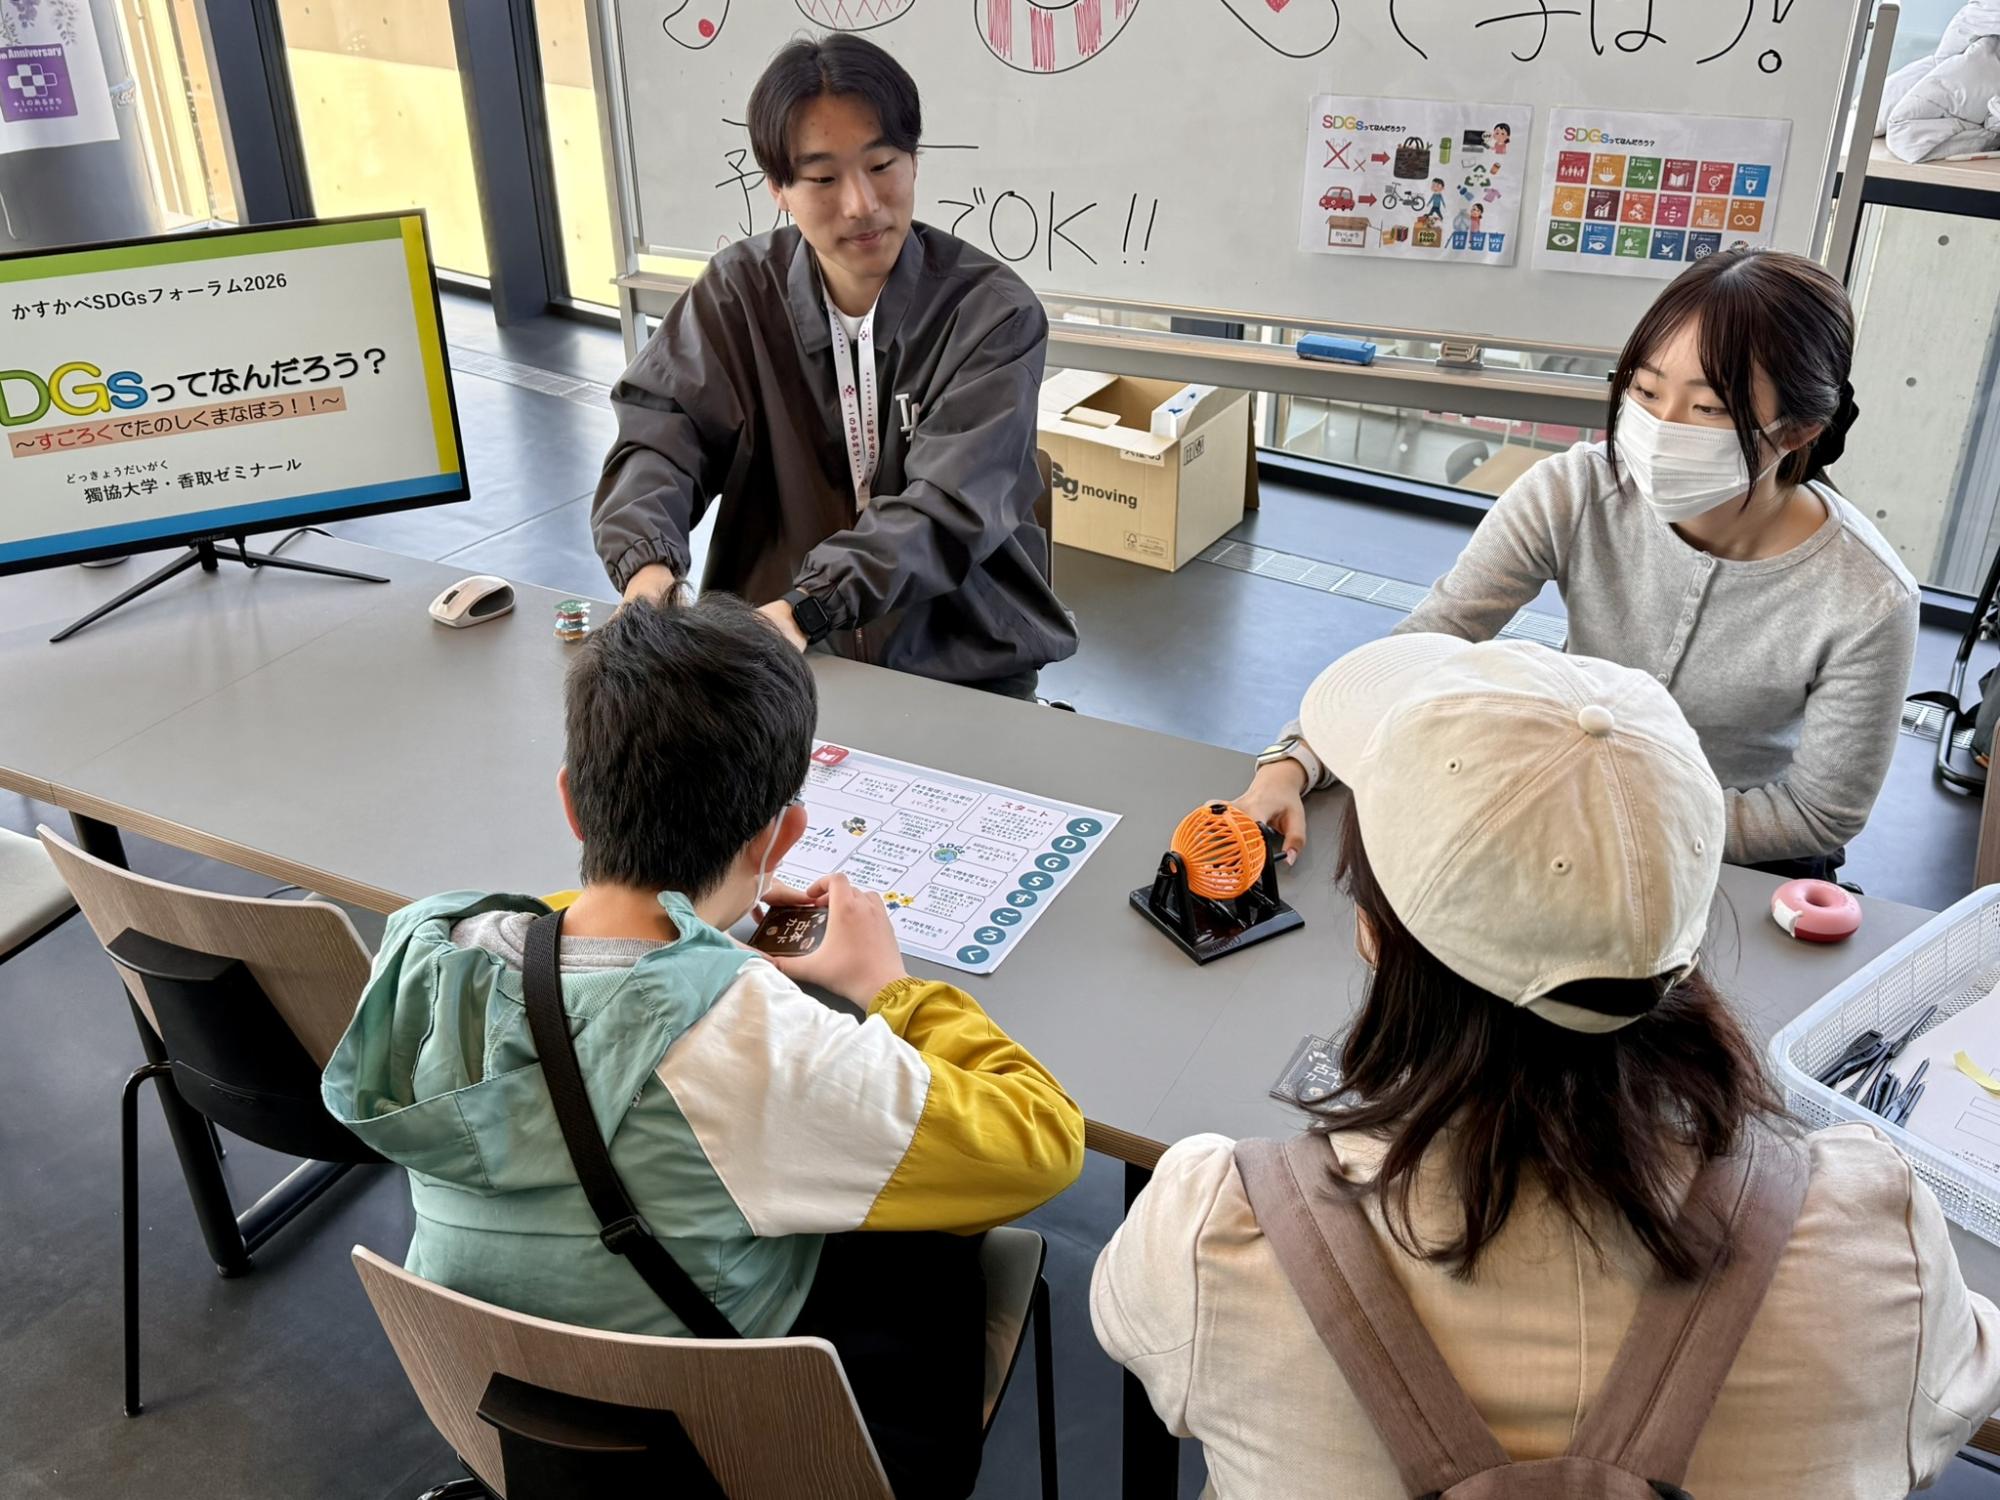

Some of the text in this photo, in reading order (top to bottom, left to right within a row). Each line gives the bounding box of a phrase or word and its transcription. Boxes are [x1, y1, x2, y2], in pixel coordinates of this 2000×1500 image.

[8, 47, 62, 58] Anniversary
[12, 272, 288, 321] かすかべSDGsフォーラム2026
[66, 459, 169, 485] どっきょうだいがく
[84, 458, 303, 505] 獨協大学・香取ゼミナール
[1081, 482, 1138, 510] moving
[1001, 800, 1050, 819] スタート
